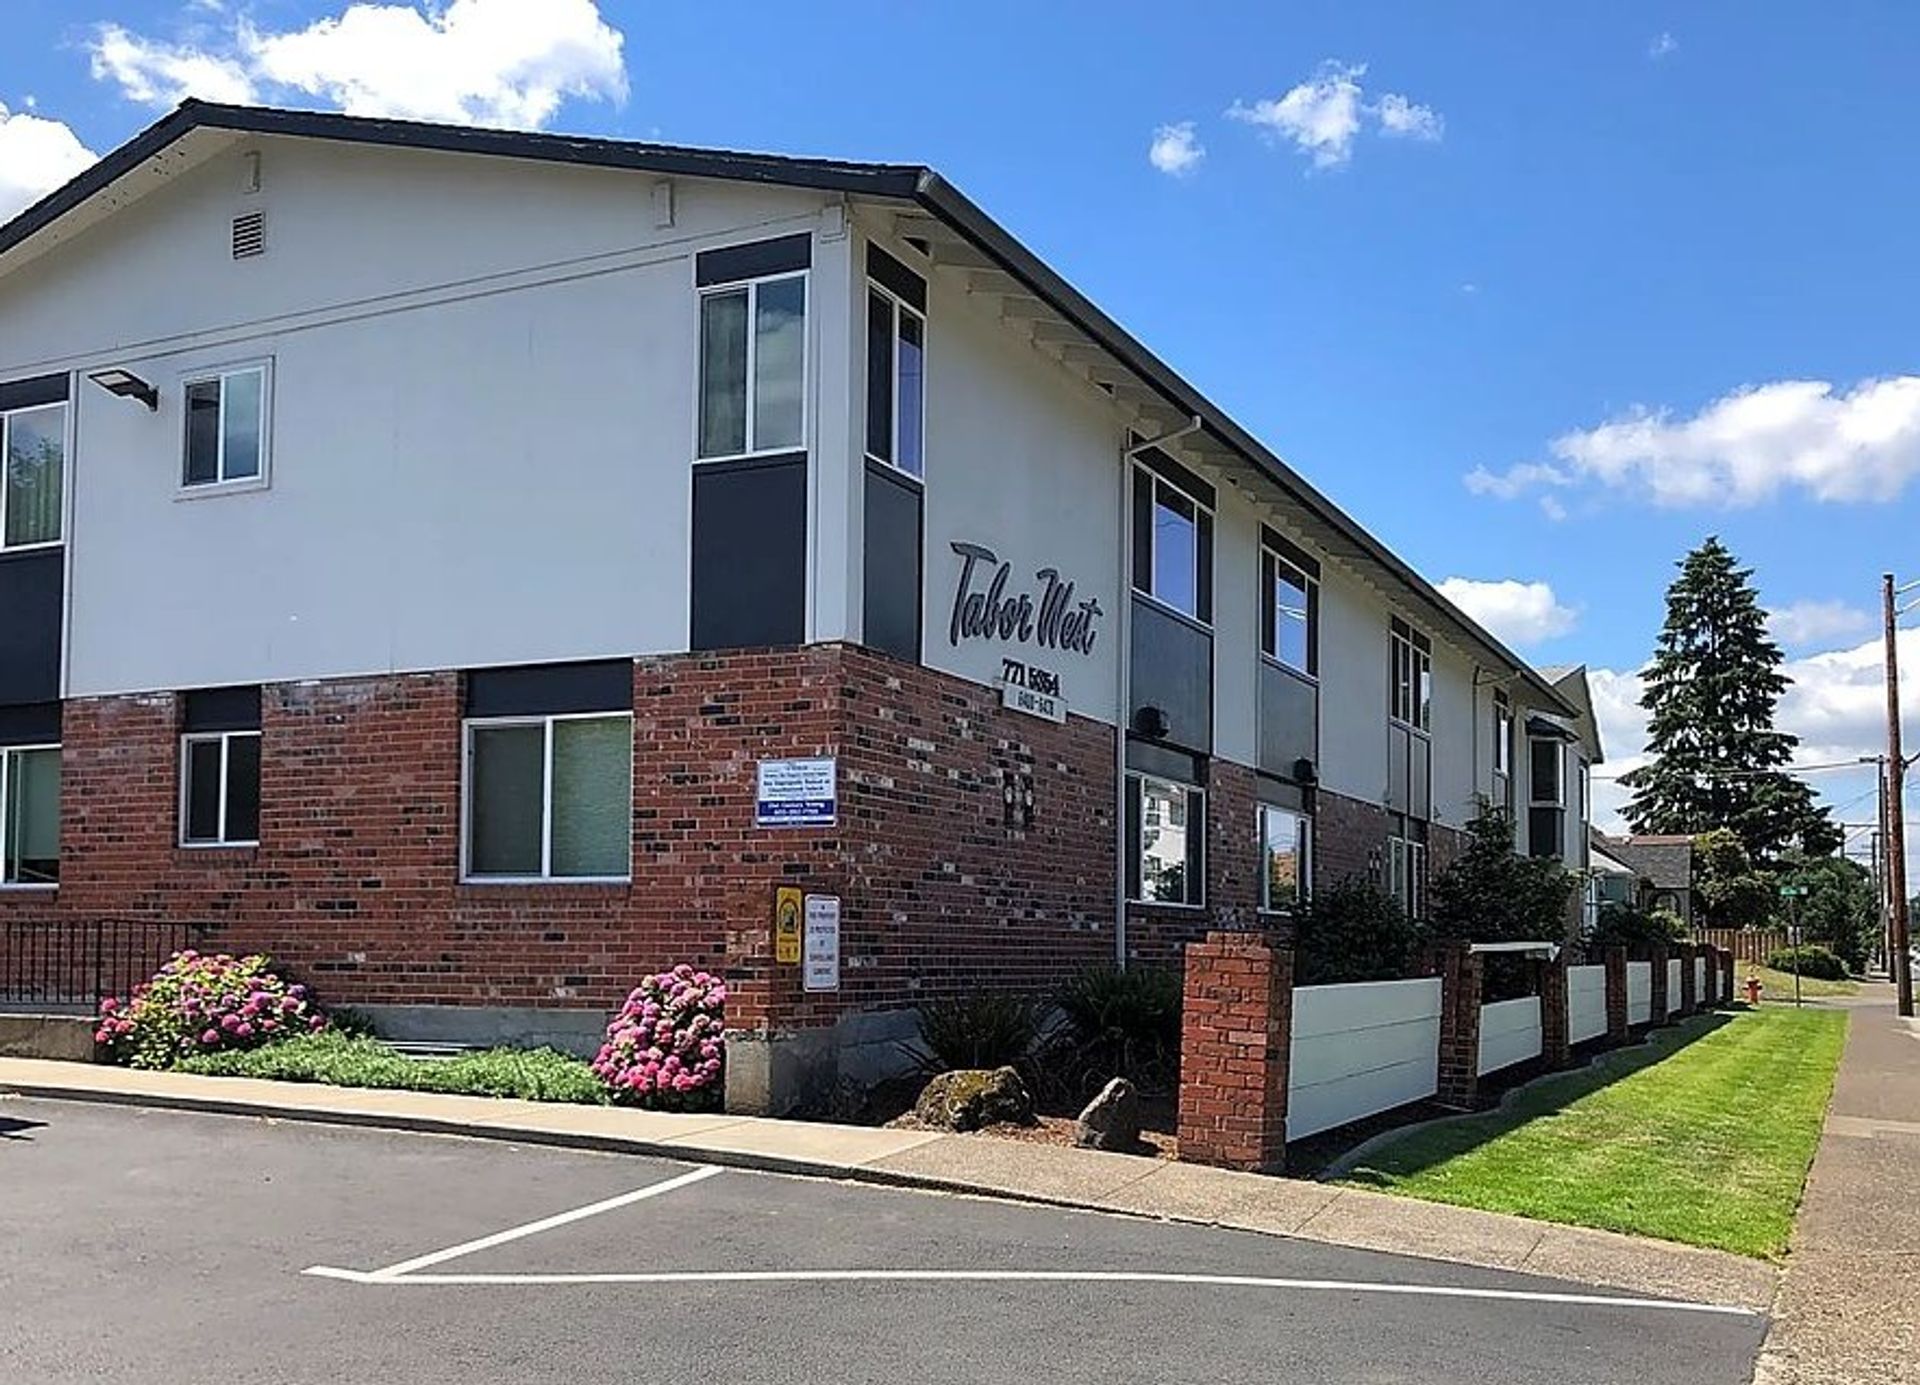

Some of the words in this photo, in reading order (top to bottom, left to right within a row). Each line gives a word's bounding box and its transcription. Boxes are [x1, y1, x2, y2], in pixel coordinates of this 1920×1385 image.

[950, 541, 1034, 647] Tabor
[1036, 567, 1104, 655] West
[1002, 658, 1025, 686] 771
